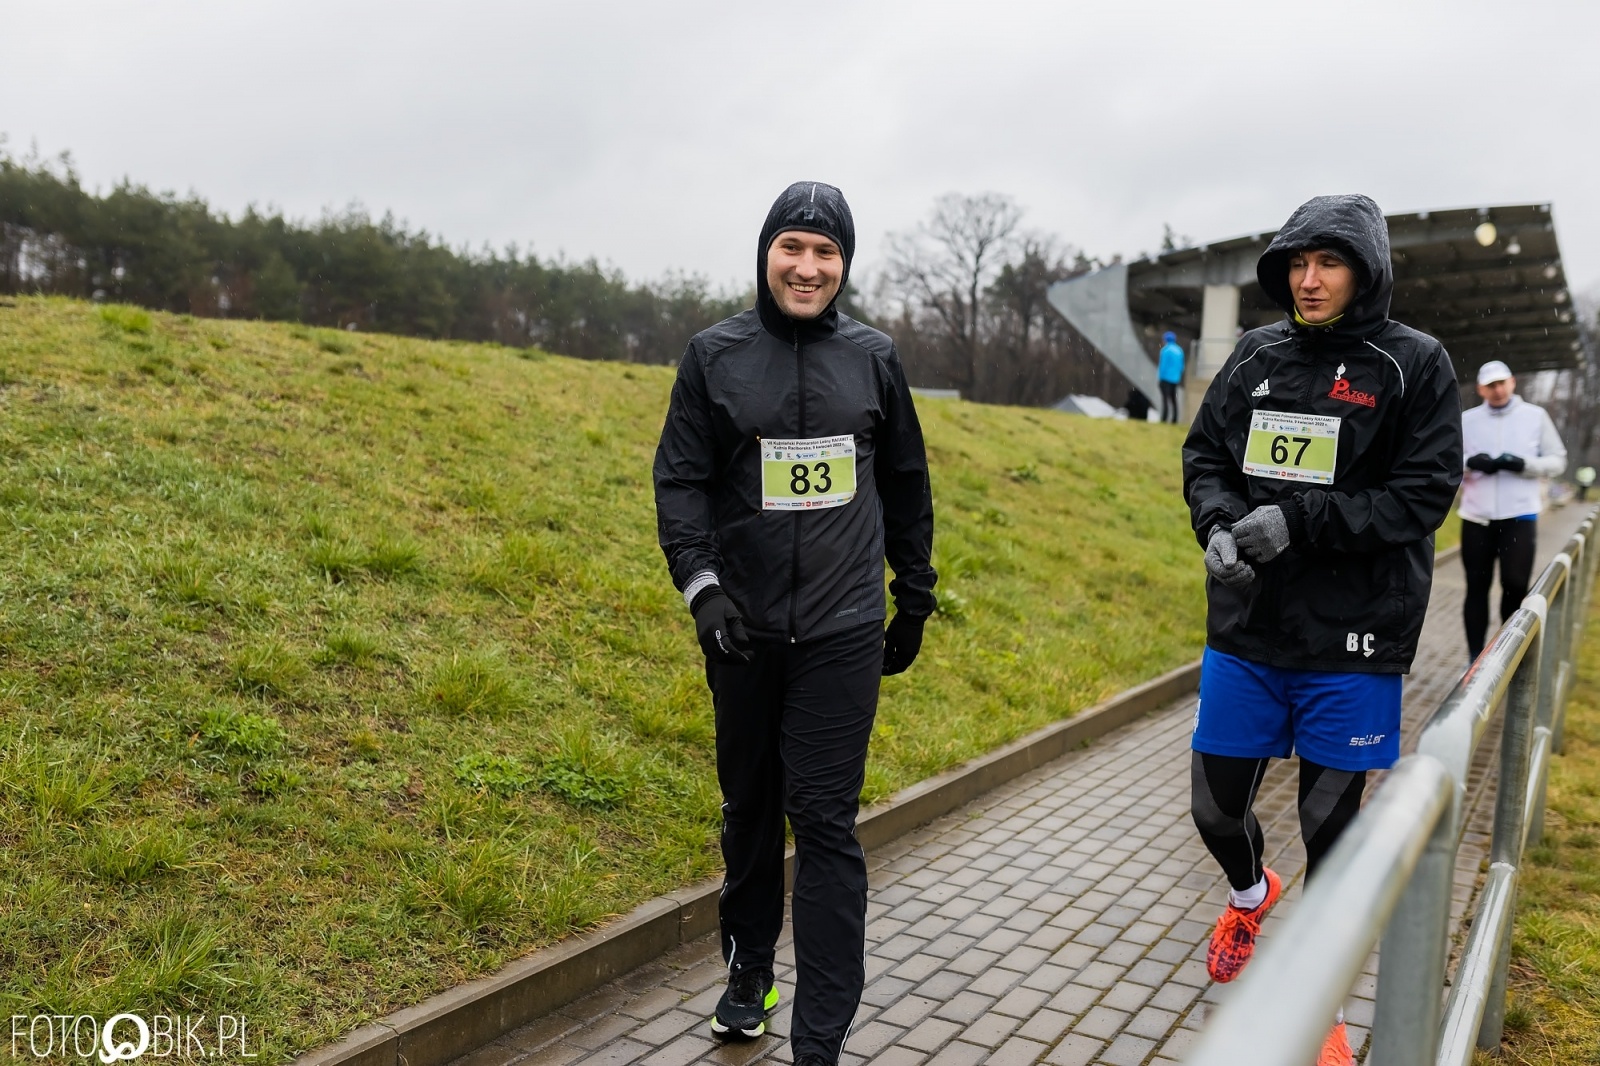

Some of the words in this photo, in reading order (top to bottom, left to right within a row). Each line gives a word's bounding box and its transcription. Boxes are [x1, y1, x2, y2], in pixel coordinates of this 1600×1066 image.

[1251, 389, 1271, 397] adidas
[1270, 435, 1312, 466] 67
[790, 462, 832, 495] 83
